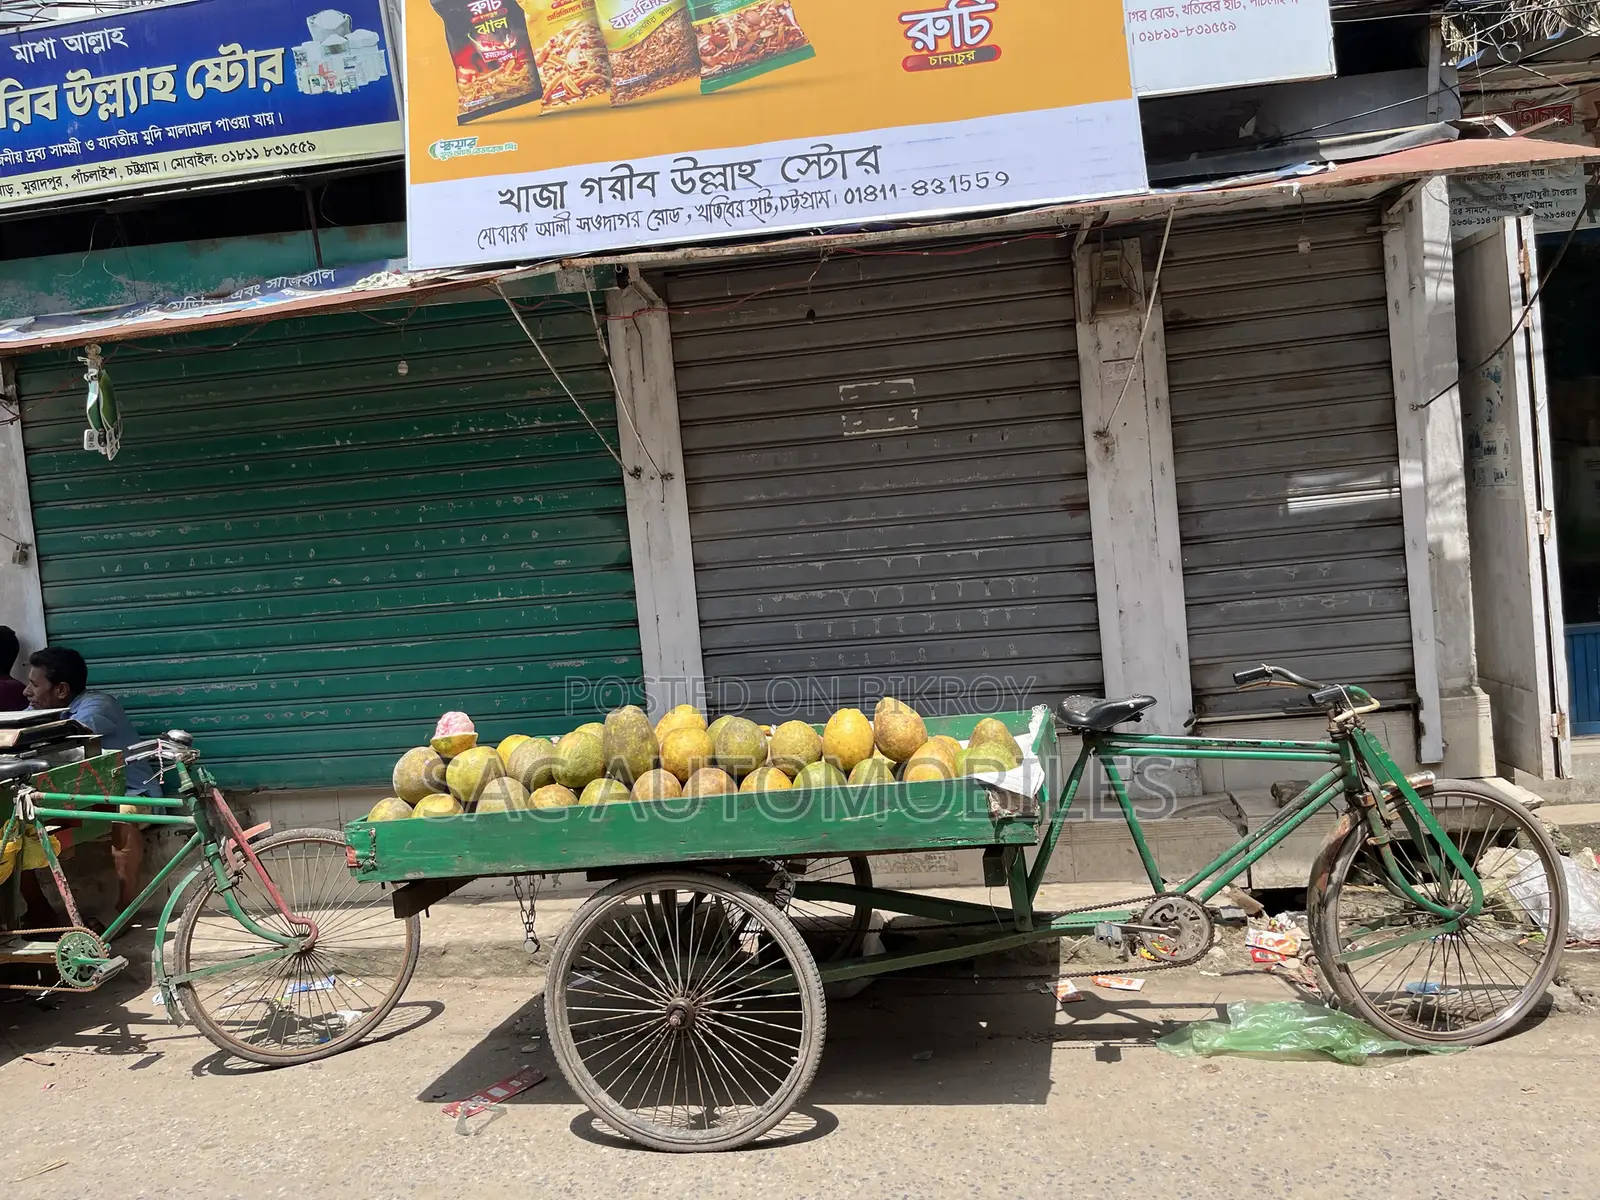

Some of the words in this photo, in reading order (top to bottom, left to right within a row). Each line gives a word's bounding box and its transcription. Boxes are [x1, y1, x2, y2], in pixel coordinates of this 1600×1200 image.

[474, 17, 509, 35] ঝাল
[1128, 10, 1148, 24] াগর
[10, 37, 57, 64] মাশা
[60, 27, 129, 55] আল্লাহ
[928, 50, 976, 66] চানাচুর
[0, 77, 58, 132] রিব
[186, 42, 285, 100] ষ্টোর
[24, 147, 47, 163] দ্রব্য
[48, 137, 82, 157] সামগ্রী
[85, 140, 95, 151] ও
[97, 129, 139, 150] যাবতীয়
[141, 124, 163, 146] মুদি
[166, 120, 213, 139] মালামাল
[215, 115, 251, 132] পাওয়া
[221, 149, 260, 164] ০১৮১১
[264, 140, 317, 158] ৮৩১৫৫৯
[498, 181, 568, 213] খাজা
[580, 163, 660, 204] গরীব
[670, 156, 763, 195] উল্লাহ
[781, 143, 883, 184] স্টোর
[477, 222, 529, 250] মোবারক
[535, 211, 571, 237] আলী
[230, 284, 262, 300] এবং
